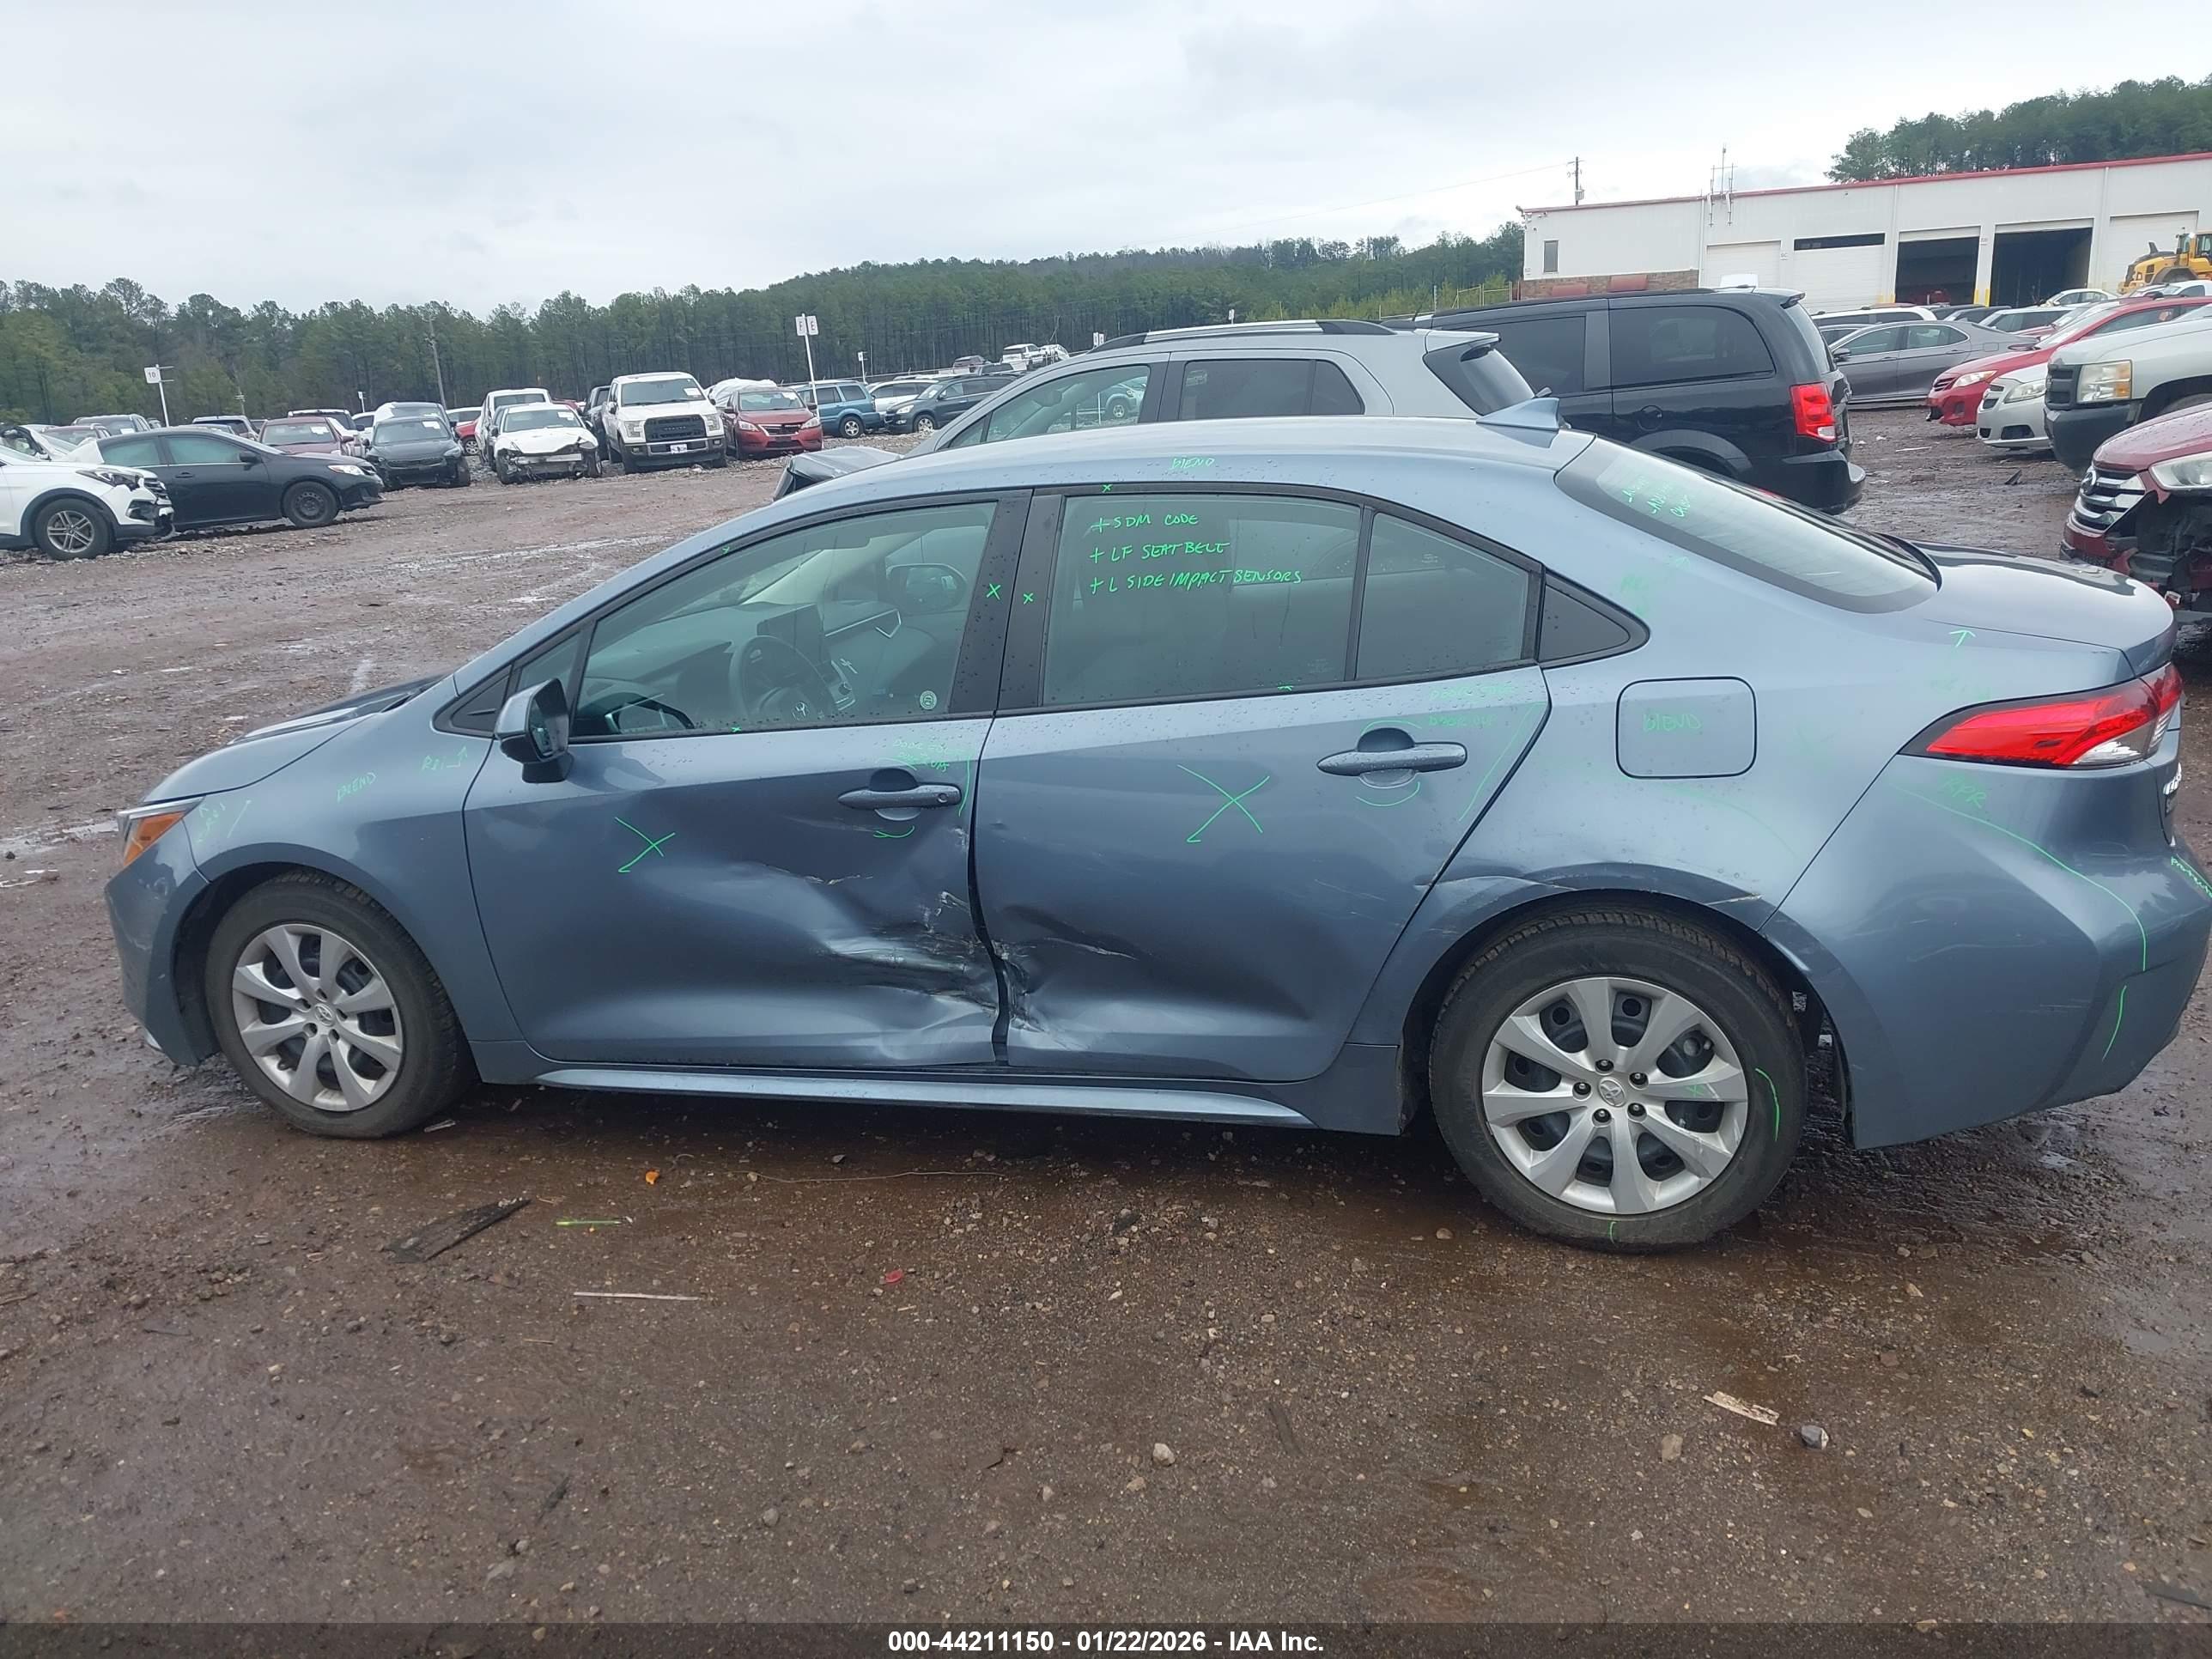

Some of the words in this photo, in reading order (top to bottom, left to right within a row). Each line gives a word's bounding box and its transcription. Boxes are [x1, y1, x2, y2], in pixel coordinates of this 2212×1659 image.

[1164, 514, 1199, 526] CODE
[1111, 546, 1133, 562] LF
[1109, 579, 1117, 592] L
[1127, 574, 1165, 589] SIDE
[1170, 569, 1232, 591] IMPACT
[1233, 570, 1302, 585] SENSORS
